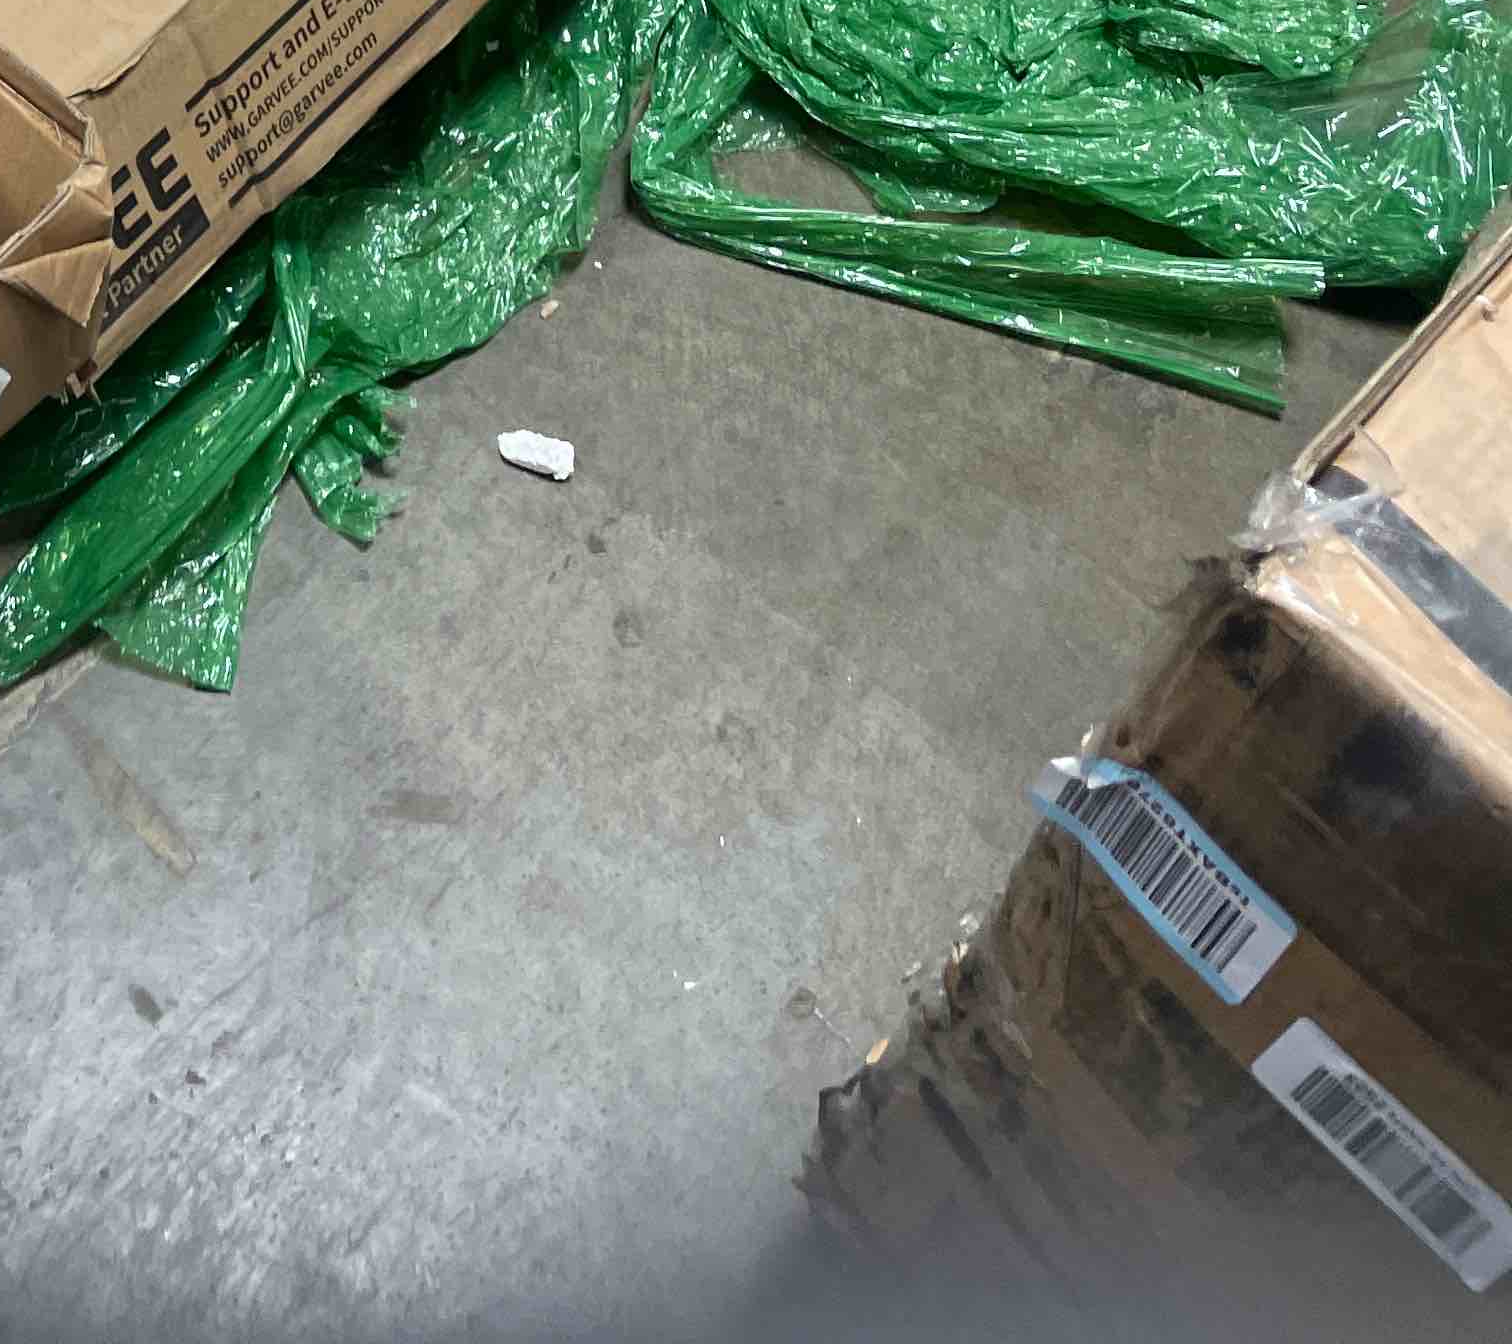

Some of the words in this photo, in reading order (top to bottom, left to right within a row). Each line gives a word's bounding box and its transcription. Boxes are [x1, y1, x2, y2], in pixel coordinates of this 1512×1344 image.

[194, 50, 282, 138] Support
[281, 6, 321, 67] and
[217, 30, 379, 190] support@garvee.com
[106, 223, 186, 310] Partner
